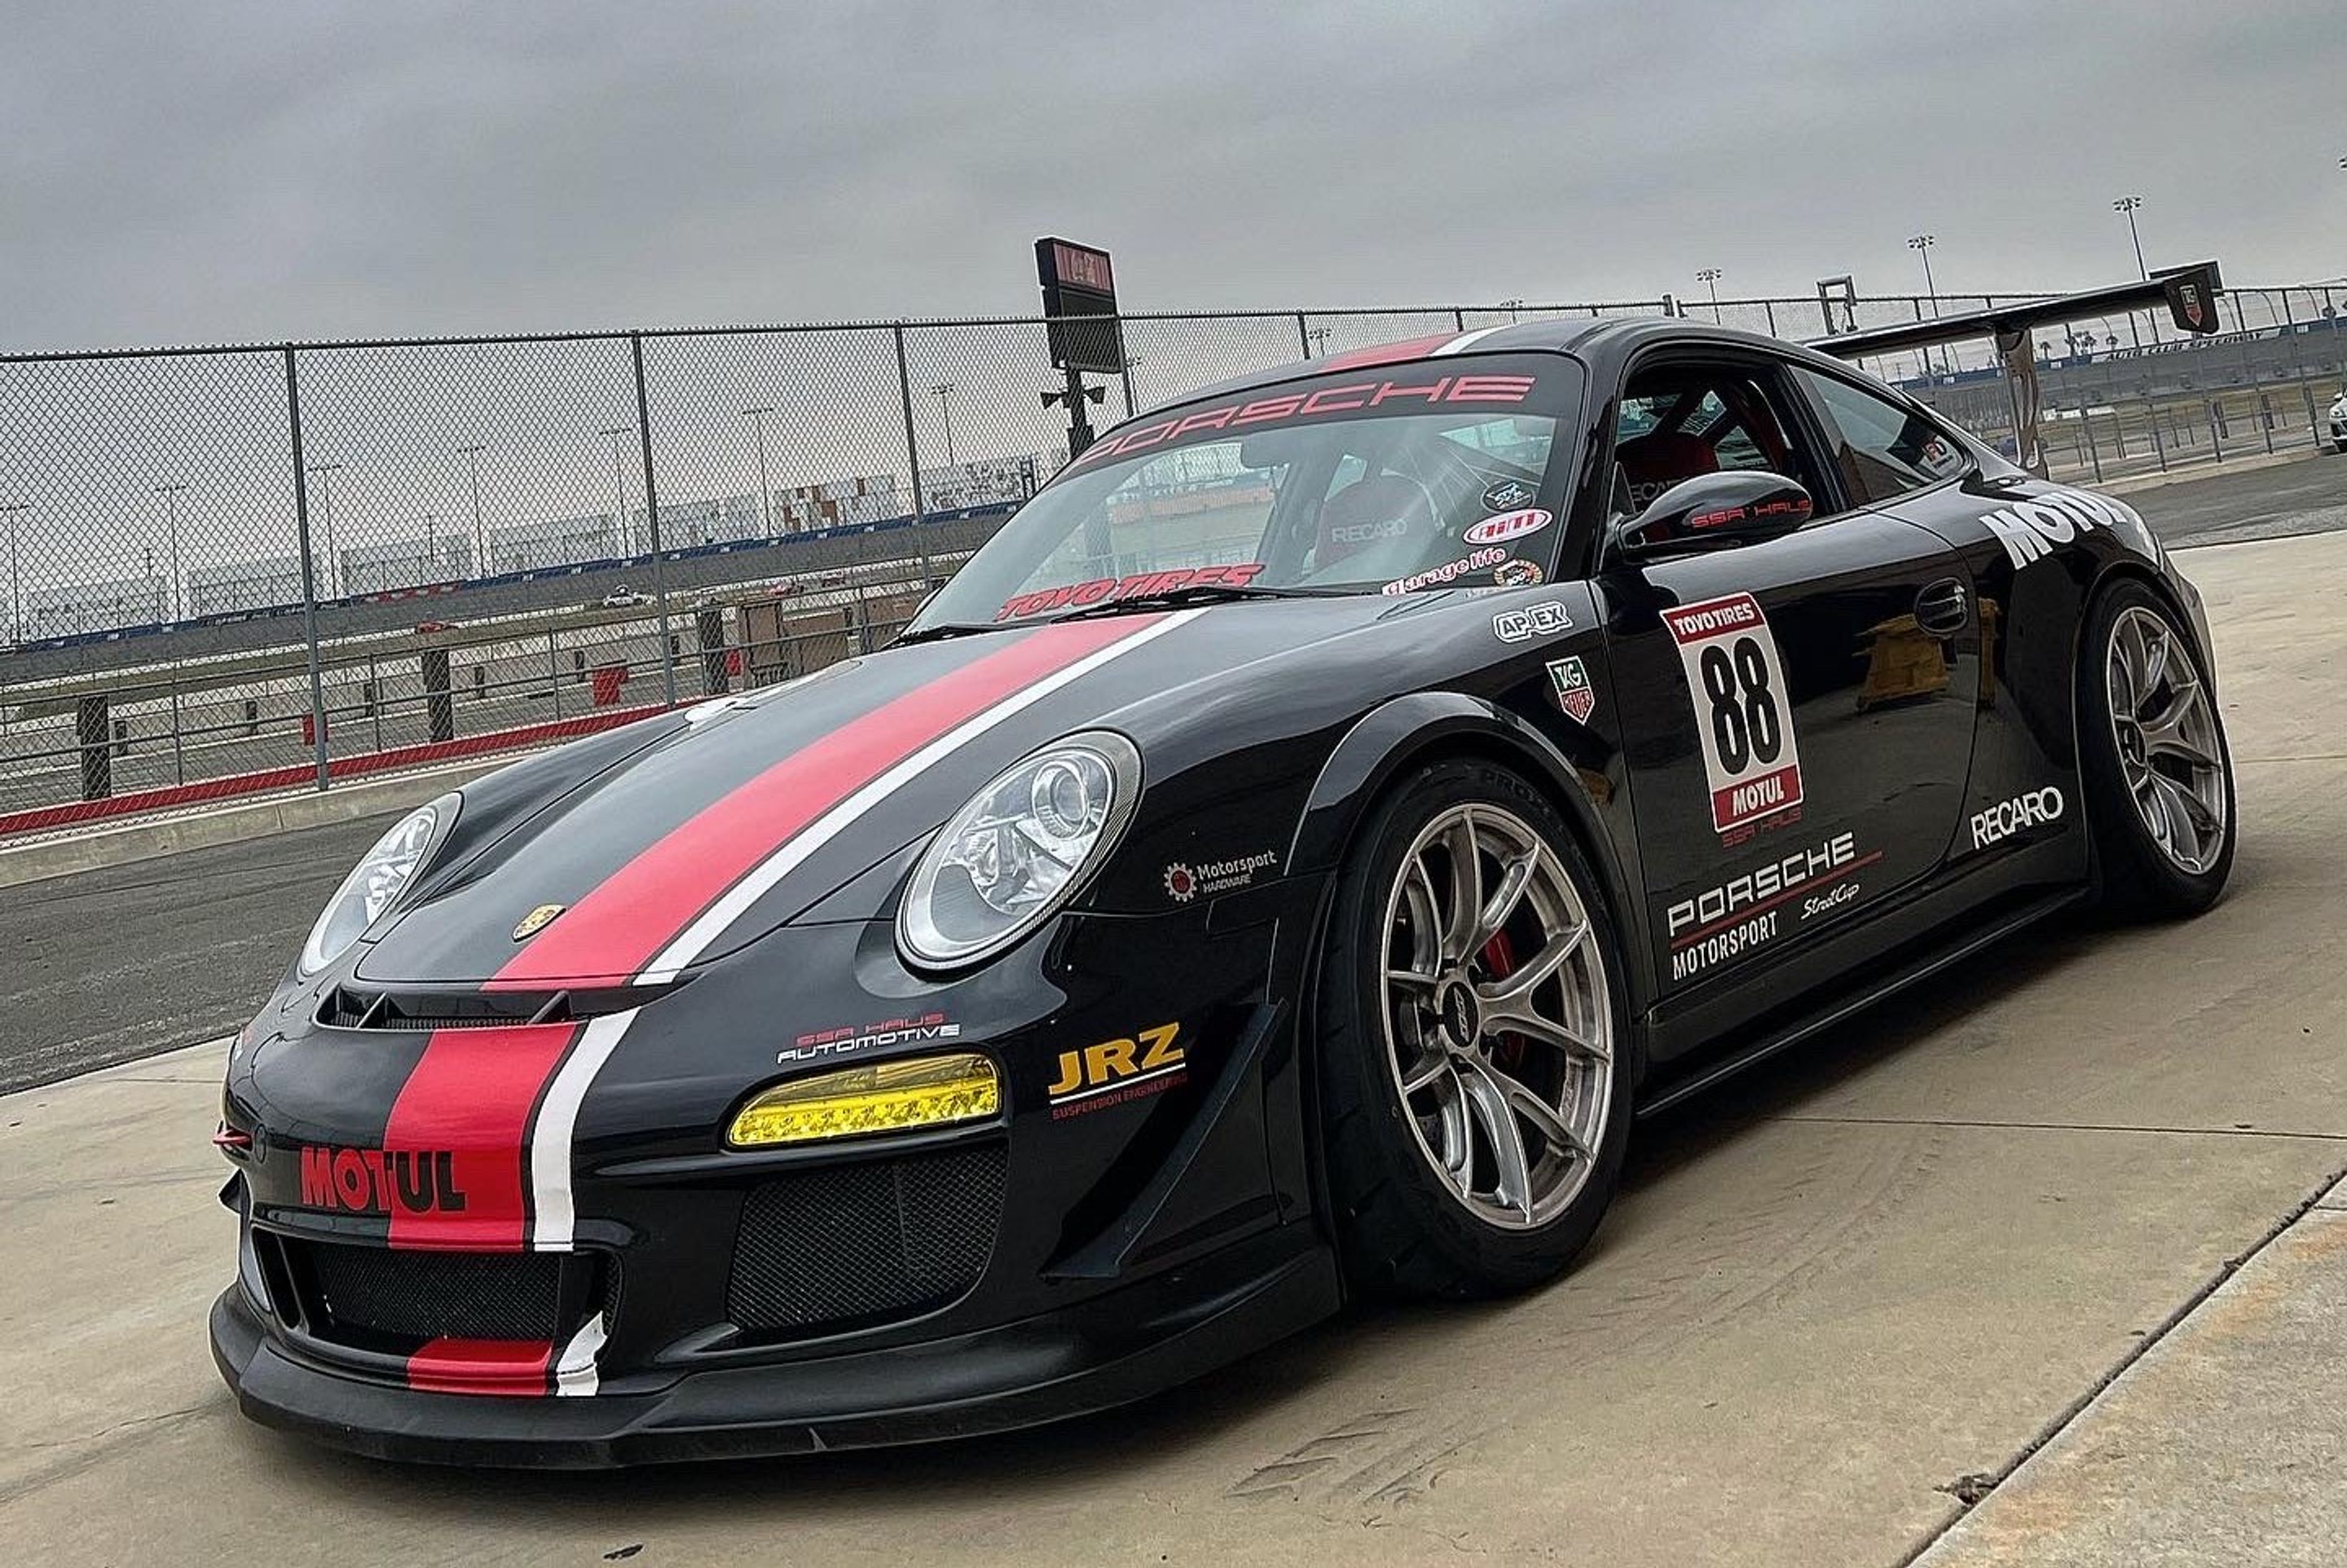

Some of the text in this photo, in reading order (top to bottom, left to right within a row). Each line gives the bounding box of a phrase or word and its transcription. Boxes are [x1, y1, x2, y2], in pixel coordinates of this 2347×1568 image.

[1063, 376, 1535, 475] PORSCHE
[1332, 518, 1407, 543] RECARO
[1700, 636, 1781, 775] 88
[1733, 775, 1785, 816] MOTUL
[1971, 786, 2064, 850] RECARO
[1196, 848, 1278, 880] Motorsport
[1667, 831, 1856, 937] PORSCHE
[1672, 910, 1777, 981] MOTORSPORT
[777, 1024, 960, 1064] AUTOMOTIVE
[1048, 1021, 1184, 1095] JRZ
[301, 1147, 467, 1212] MOTUL
